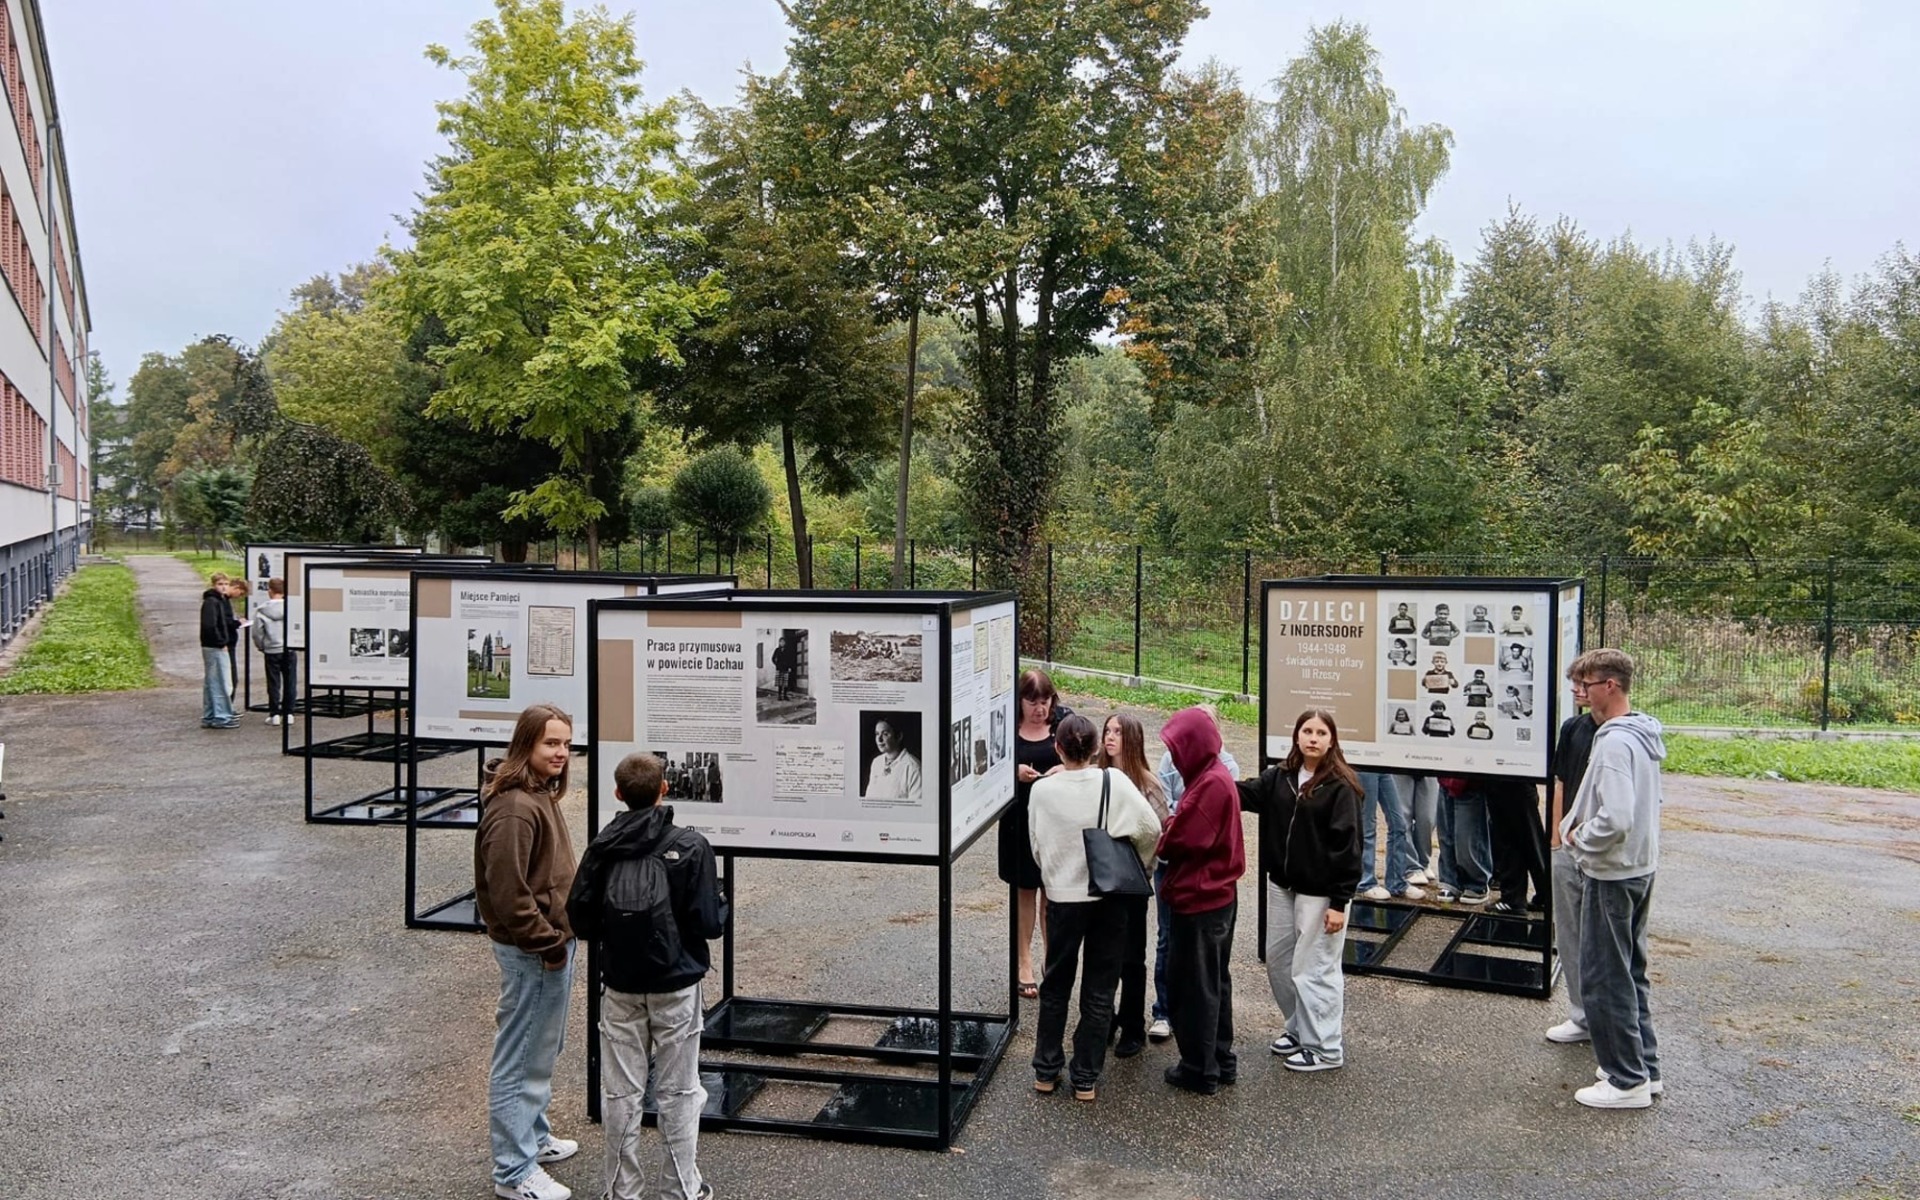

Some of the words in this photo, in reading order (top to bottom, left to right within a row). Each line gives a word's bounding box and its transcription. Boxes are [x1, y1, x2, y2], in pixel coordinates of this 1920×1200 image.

[460, 591, 489, 602] Miejsce
[490, 592, 521, 604] Pamięci
[1280, 600, 1365, 622] DZIECI
[1280, 624, 1287, 636] Z
[1290, 624, 1364, 638] INDERSDORF
[646, 639, 676, 652] Praca
[679, 642, 742, 654] przymusowa
[1298, 642, 1346, 655] 1944-1948
[646, 659, 655, 669] w
[658, 657, 703, 671] powiecie
[706, 657, 744, 670] Dachau
[1285, 654, 1333, 667] świadkowie
[1340, 657, 1364, 670] ofiary
[1301, 668, 1311, 679] III
[1312, 668, 1341, 682] Rzeszy
